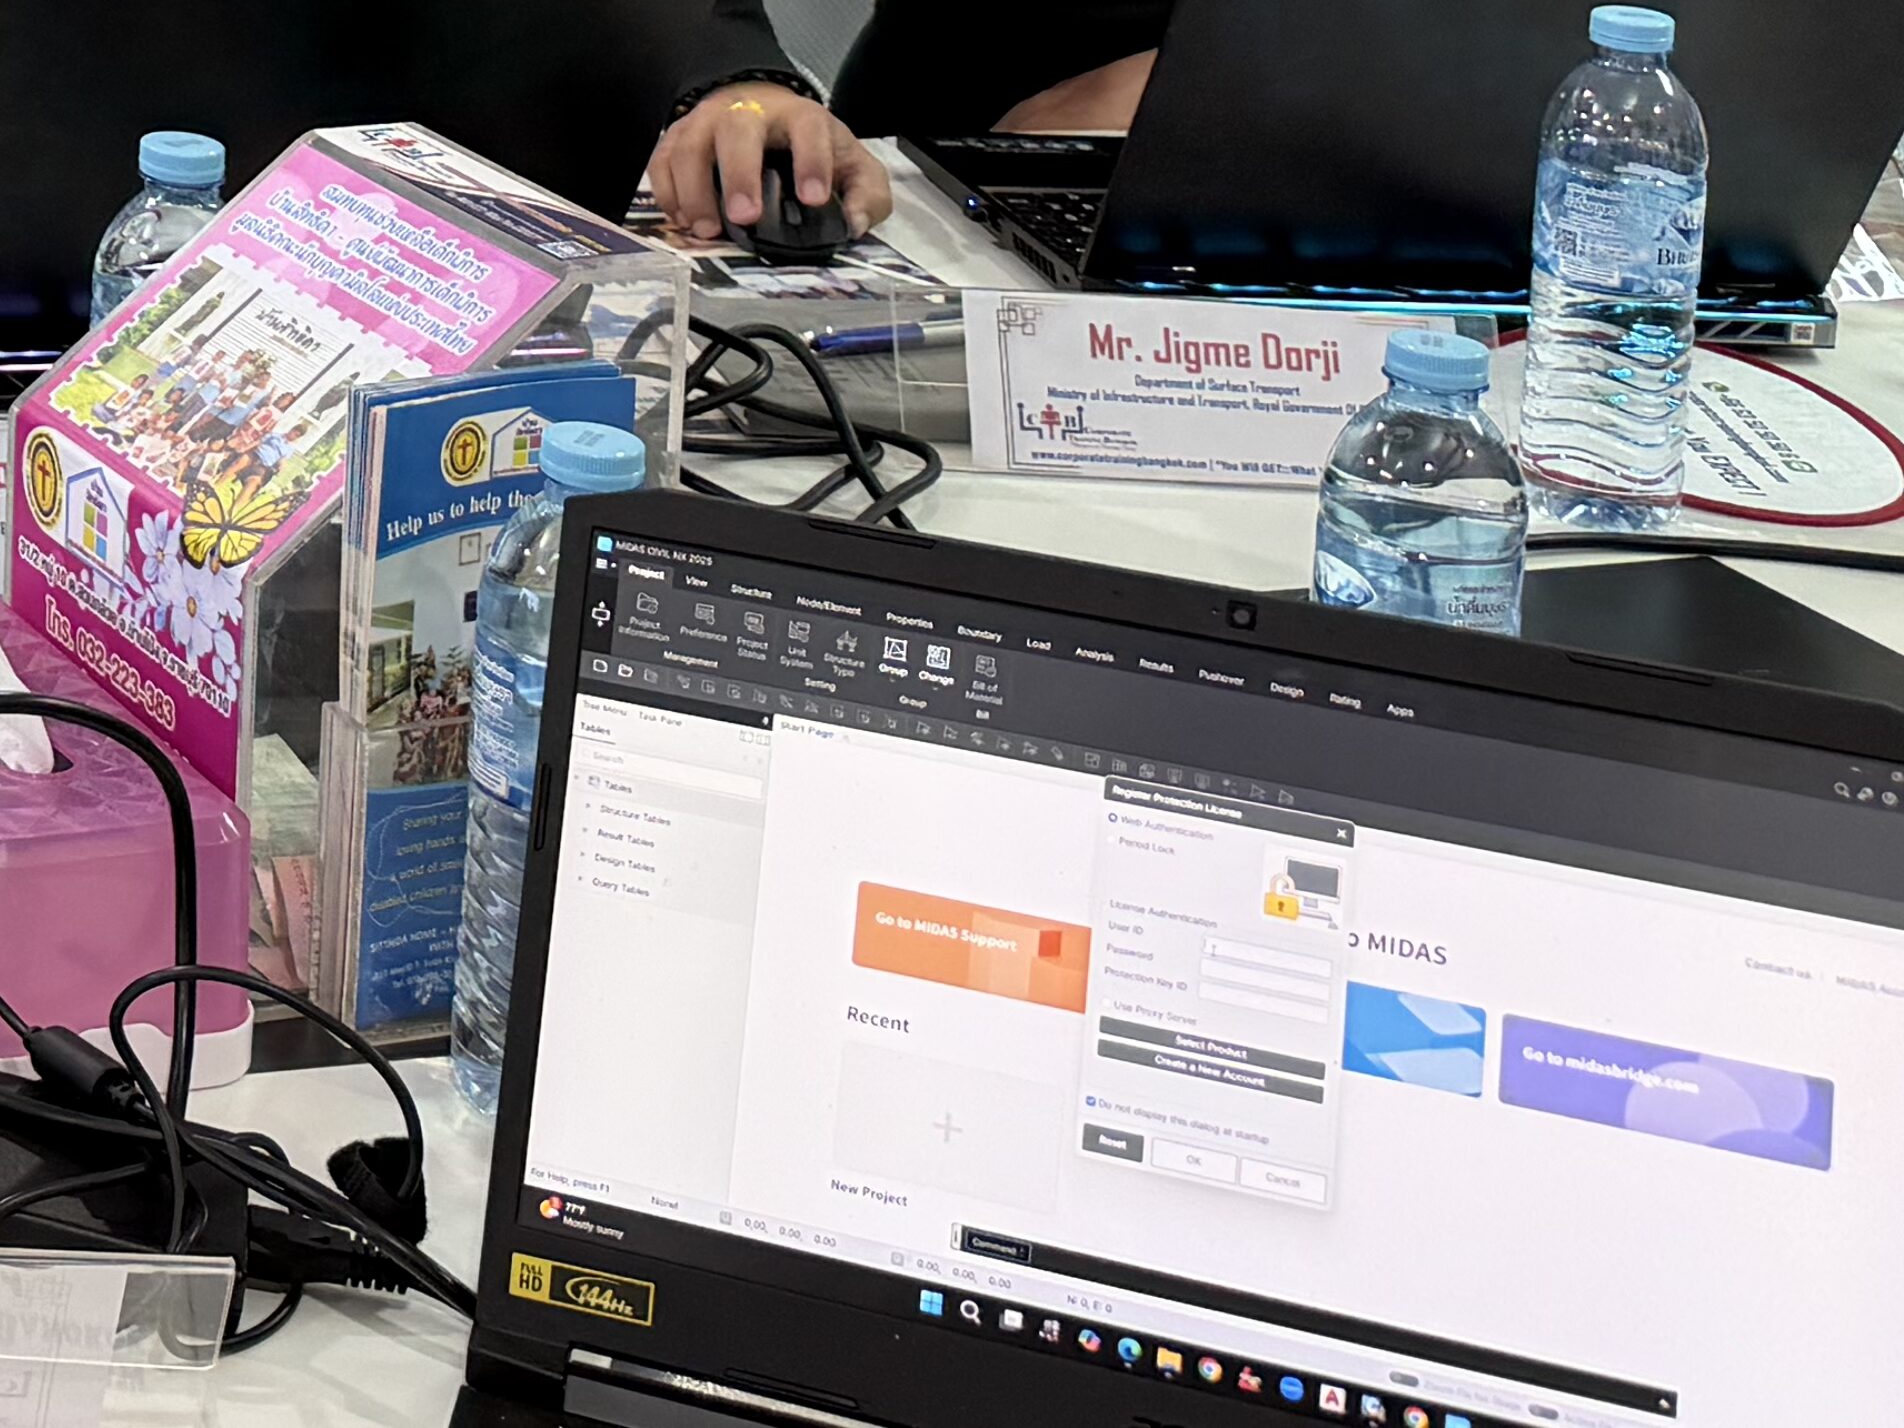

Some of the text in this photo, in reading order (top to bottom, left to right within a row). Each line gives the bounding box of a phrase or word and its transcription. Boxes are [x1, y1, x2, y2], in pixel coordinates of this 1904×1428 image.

[1088, 322, 1342, 382] Mr. Jigme Dorji
[1134, 373, 1192, 391] Department
[1249, 380, 1301, 397] Transport
[386, 490, 503, 543] Help us to help
[685, 574, 709, 588] View
[1026, 637, 1052, 651] Load
[874, 910, 1018, 953] Go to MIDAS Support
[1366, 932, 1448, 966] MIDAS
[846, 1004, 911, 1035] Recent
[1521, 1046, 1701, 1095] Go to midasbridge.com
[830, 1178, 909, 1208] New Project
[518, 1273, 543, 1294] HD
